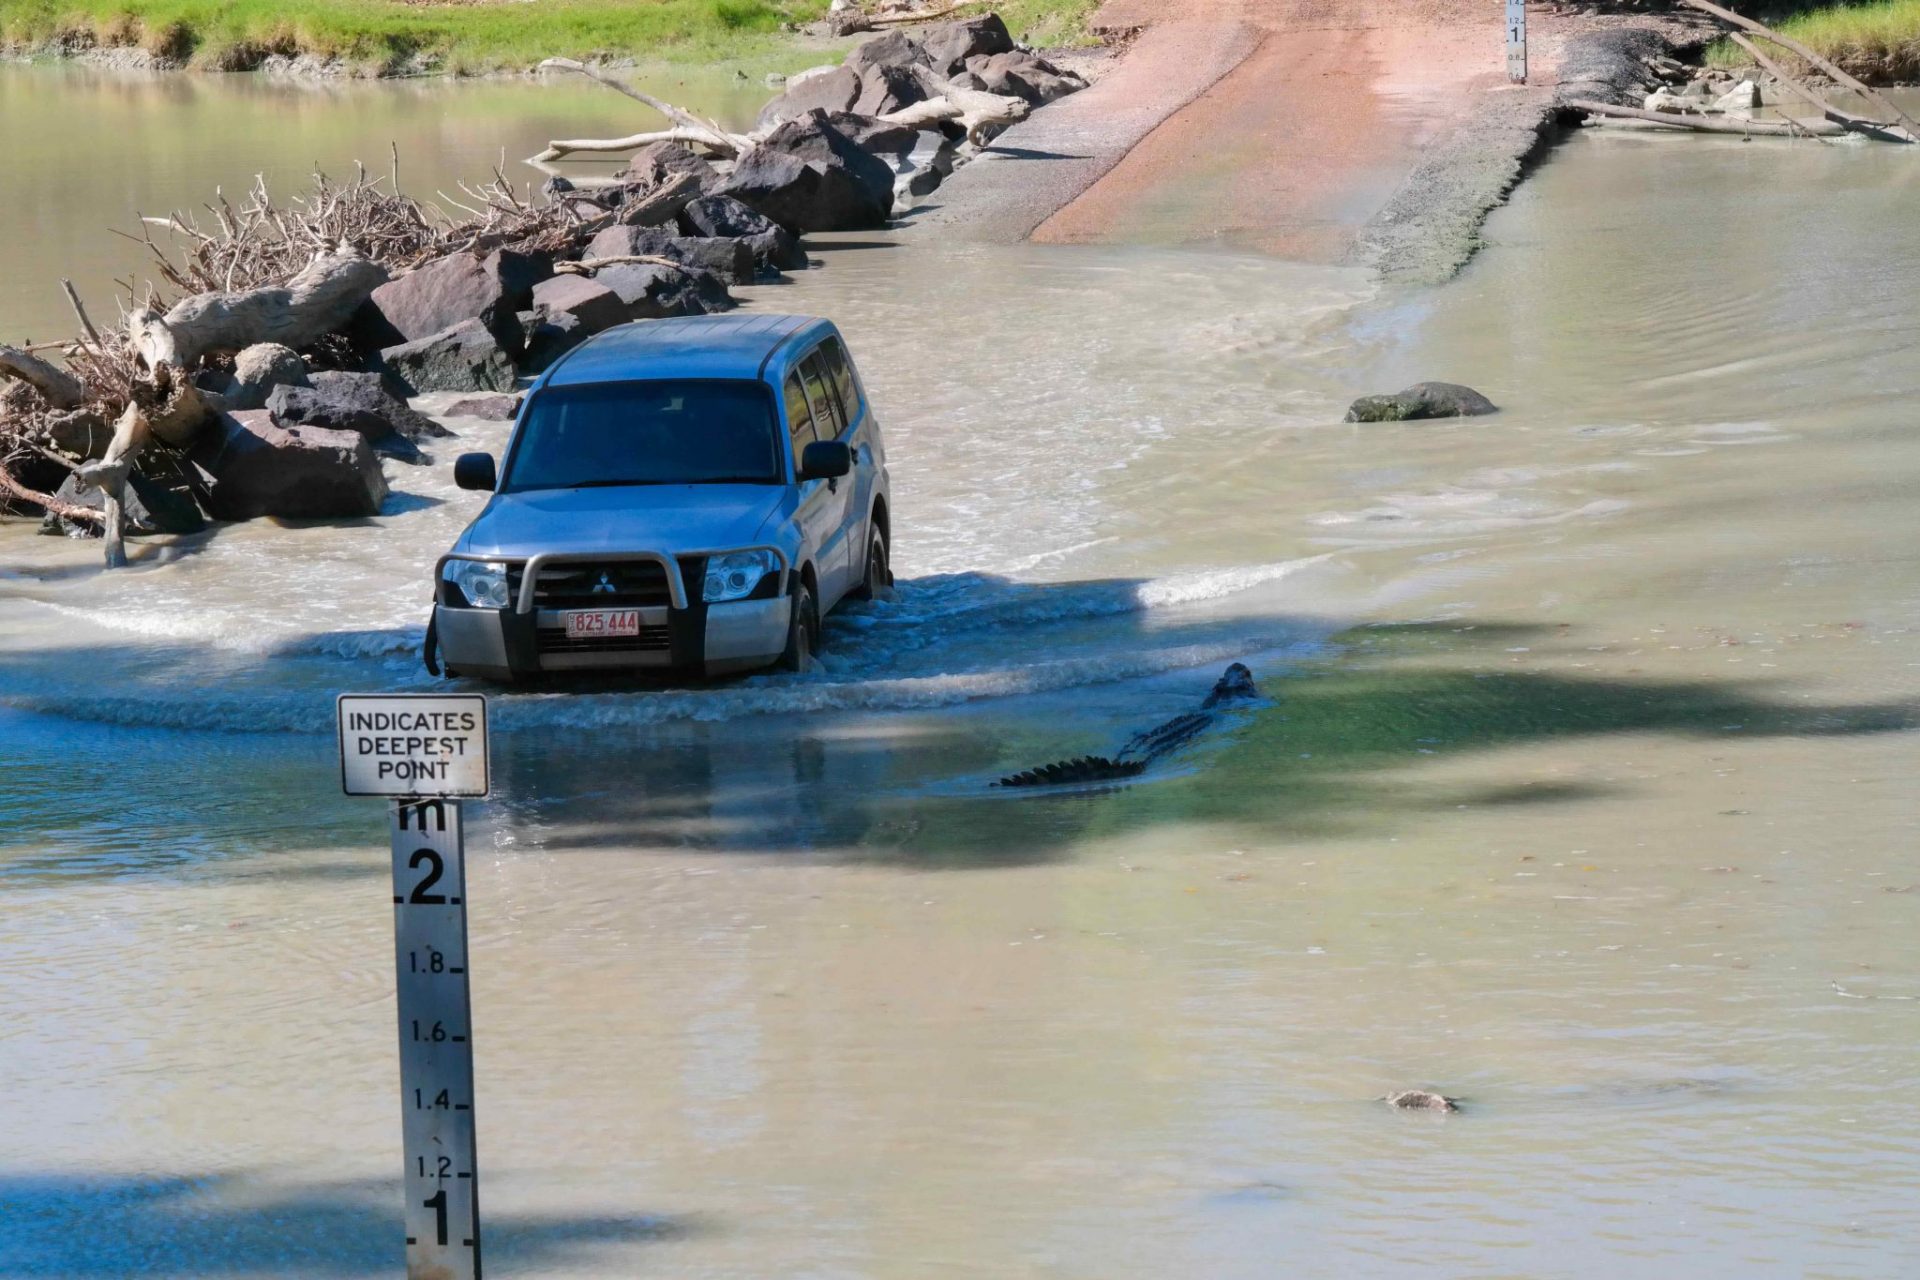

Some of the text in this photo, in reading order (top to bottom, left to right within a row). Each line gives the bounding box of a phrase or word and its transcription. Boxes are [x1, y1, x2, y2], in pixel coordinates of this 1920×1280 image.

[1510, 26, 1518, 42] 1
[576, 613, 636, 631] 825 444
[350, 712, 475, 731] INDICATES
[358, 737, 468, 755] DEEPEST
[378, 760, 450, 780] POINT
[398, 799, 446, 832] m
[409, 848, 446, 904] 2
[410, 951, 444, 974] 1.8
[412, 1020, 446, 1042] 1.6
[414, 1087, 450, 1110] 1.4
[418, 1156, 452, 1178] 1.2
[423, 1190, 448, 1246] 1
